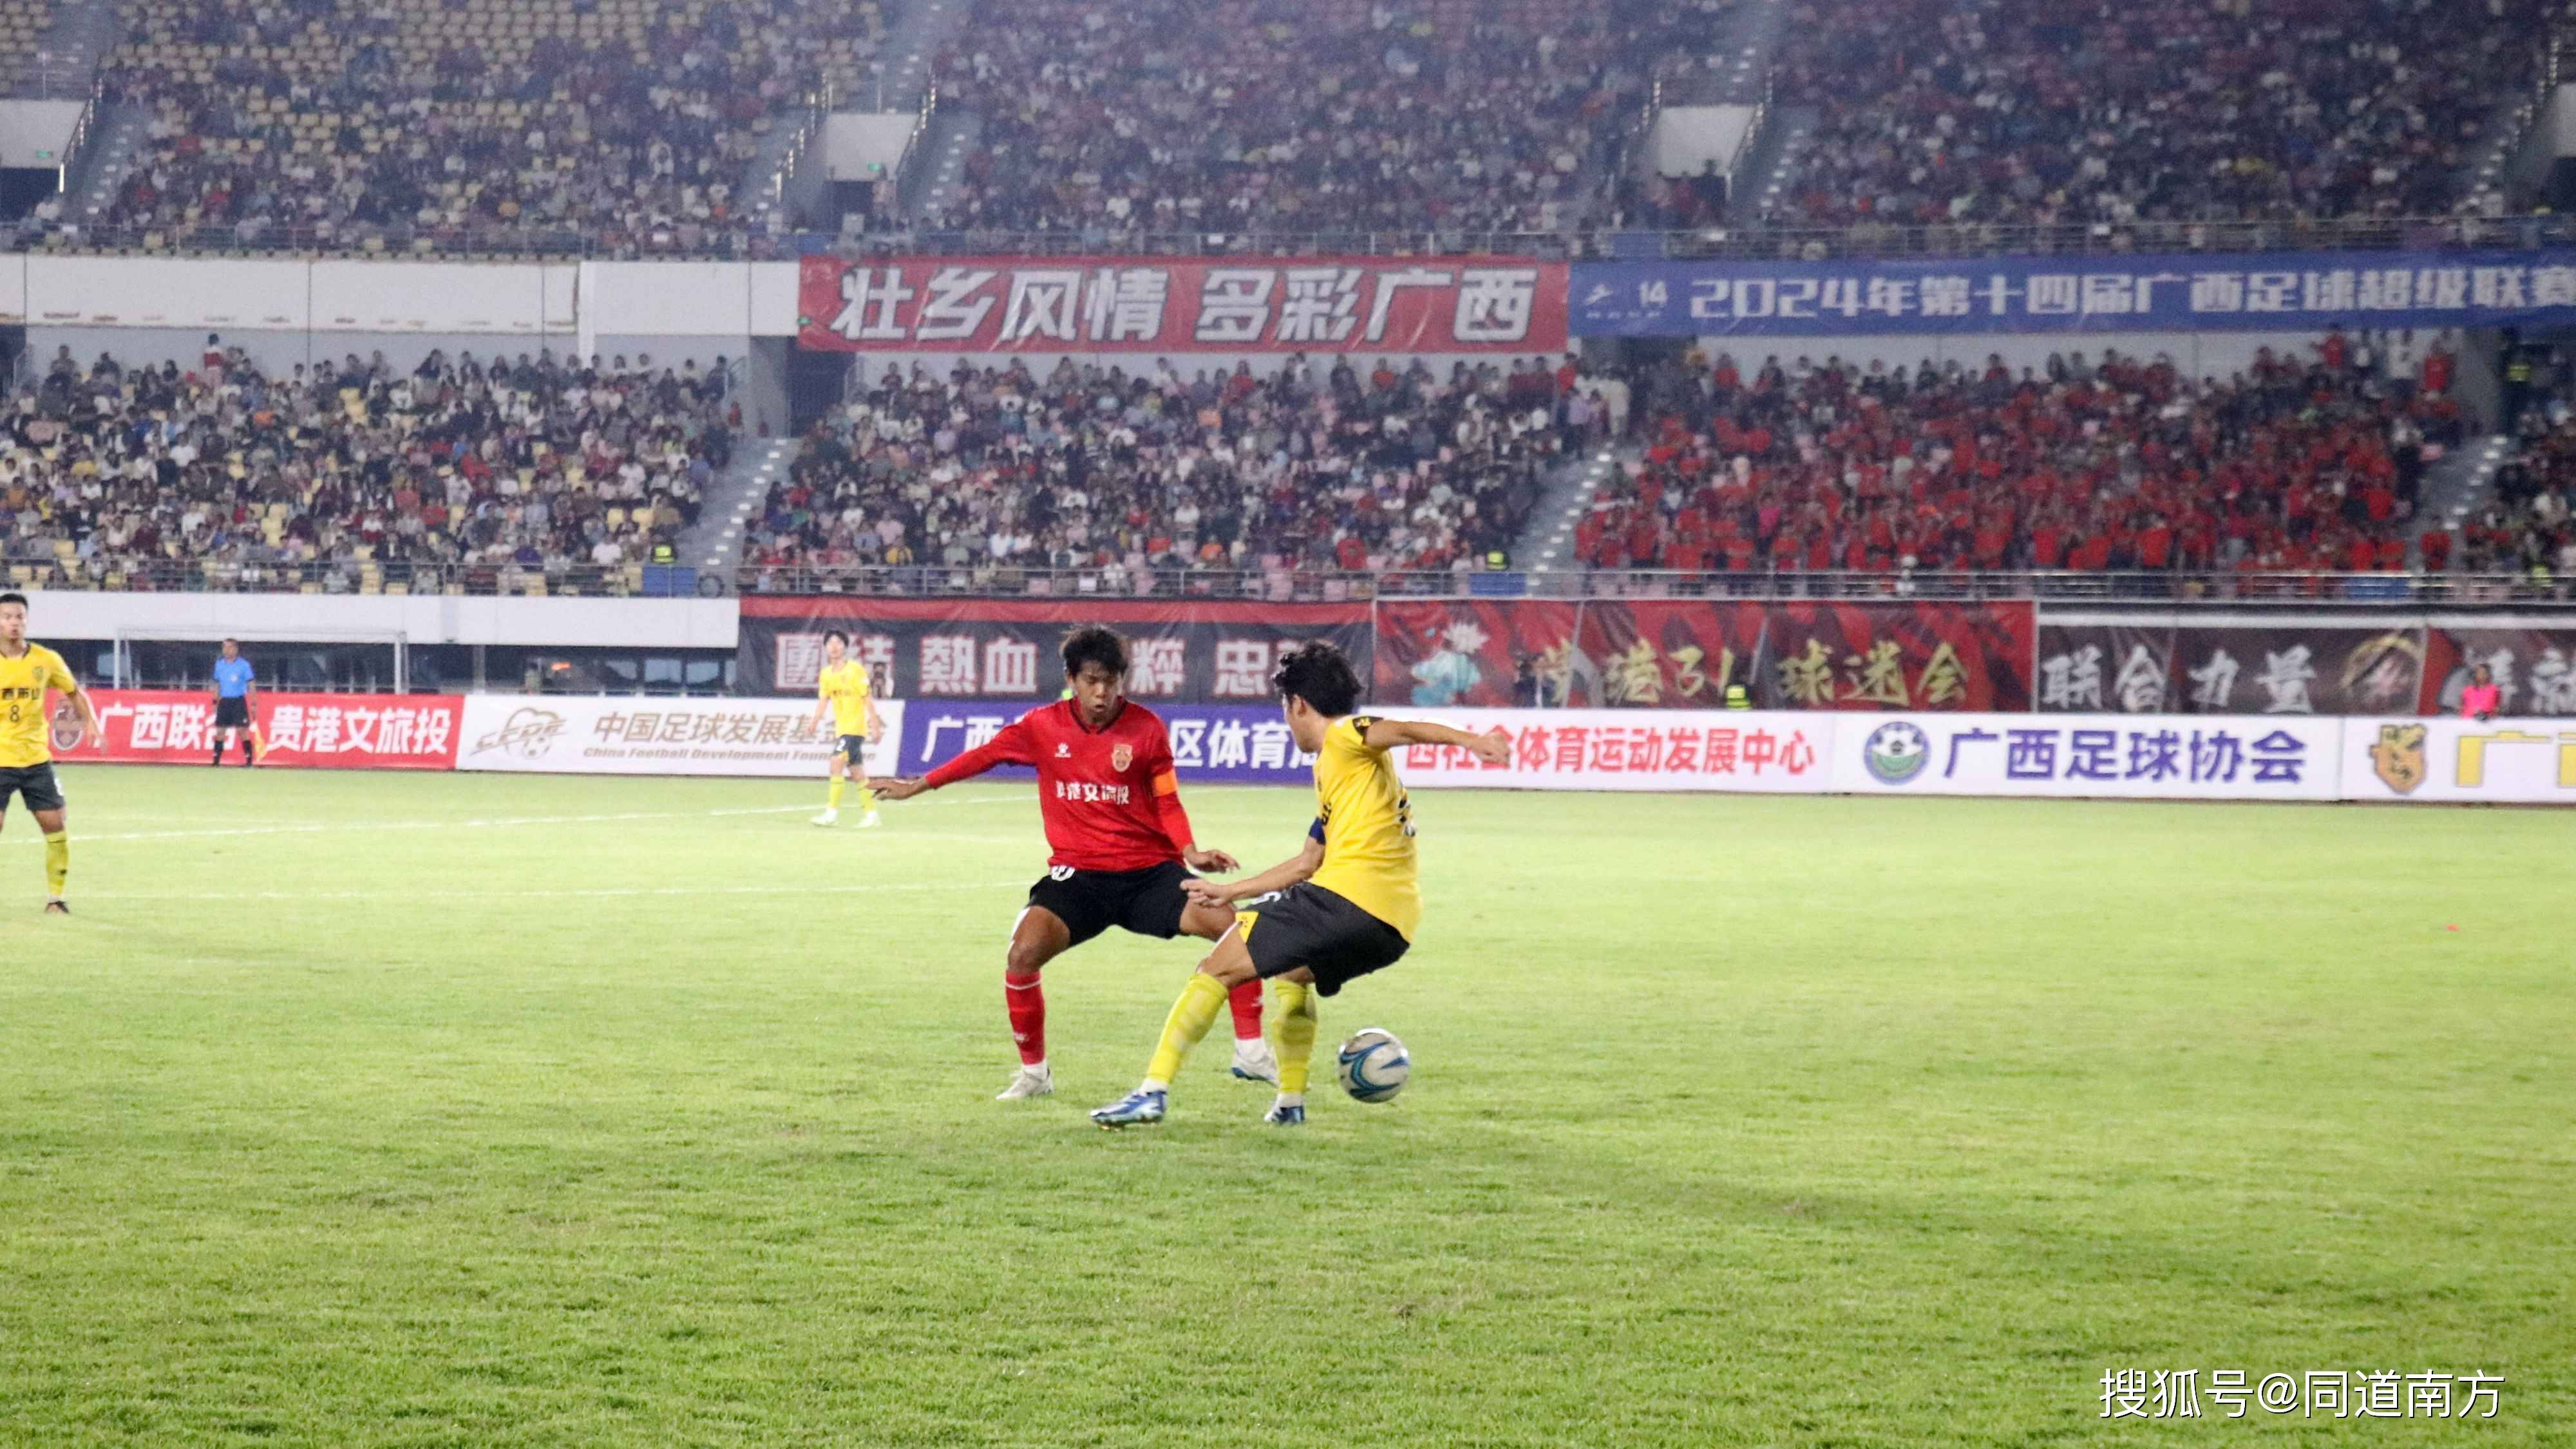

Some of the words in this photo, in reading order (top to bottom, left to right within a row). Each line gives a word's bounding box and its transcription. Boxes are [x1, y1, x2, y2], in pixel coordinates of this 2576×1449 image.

[830, 267, 1168, 342] 壮乡风情
[1193, 267, 1537, 342] 多彩广西
[10, 705, 19, 723] 8
[266, 706, 450, 755] 贵港文旅投
[583, 747, 625, 758] China
[629, 748, 689, 759] Football
[690, 748, 789, 761] Development
[1944, 727, 2306, 782] 广西足球协会
[2456, 730, 2576, 788] 广
